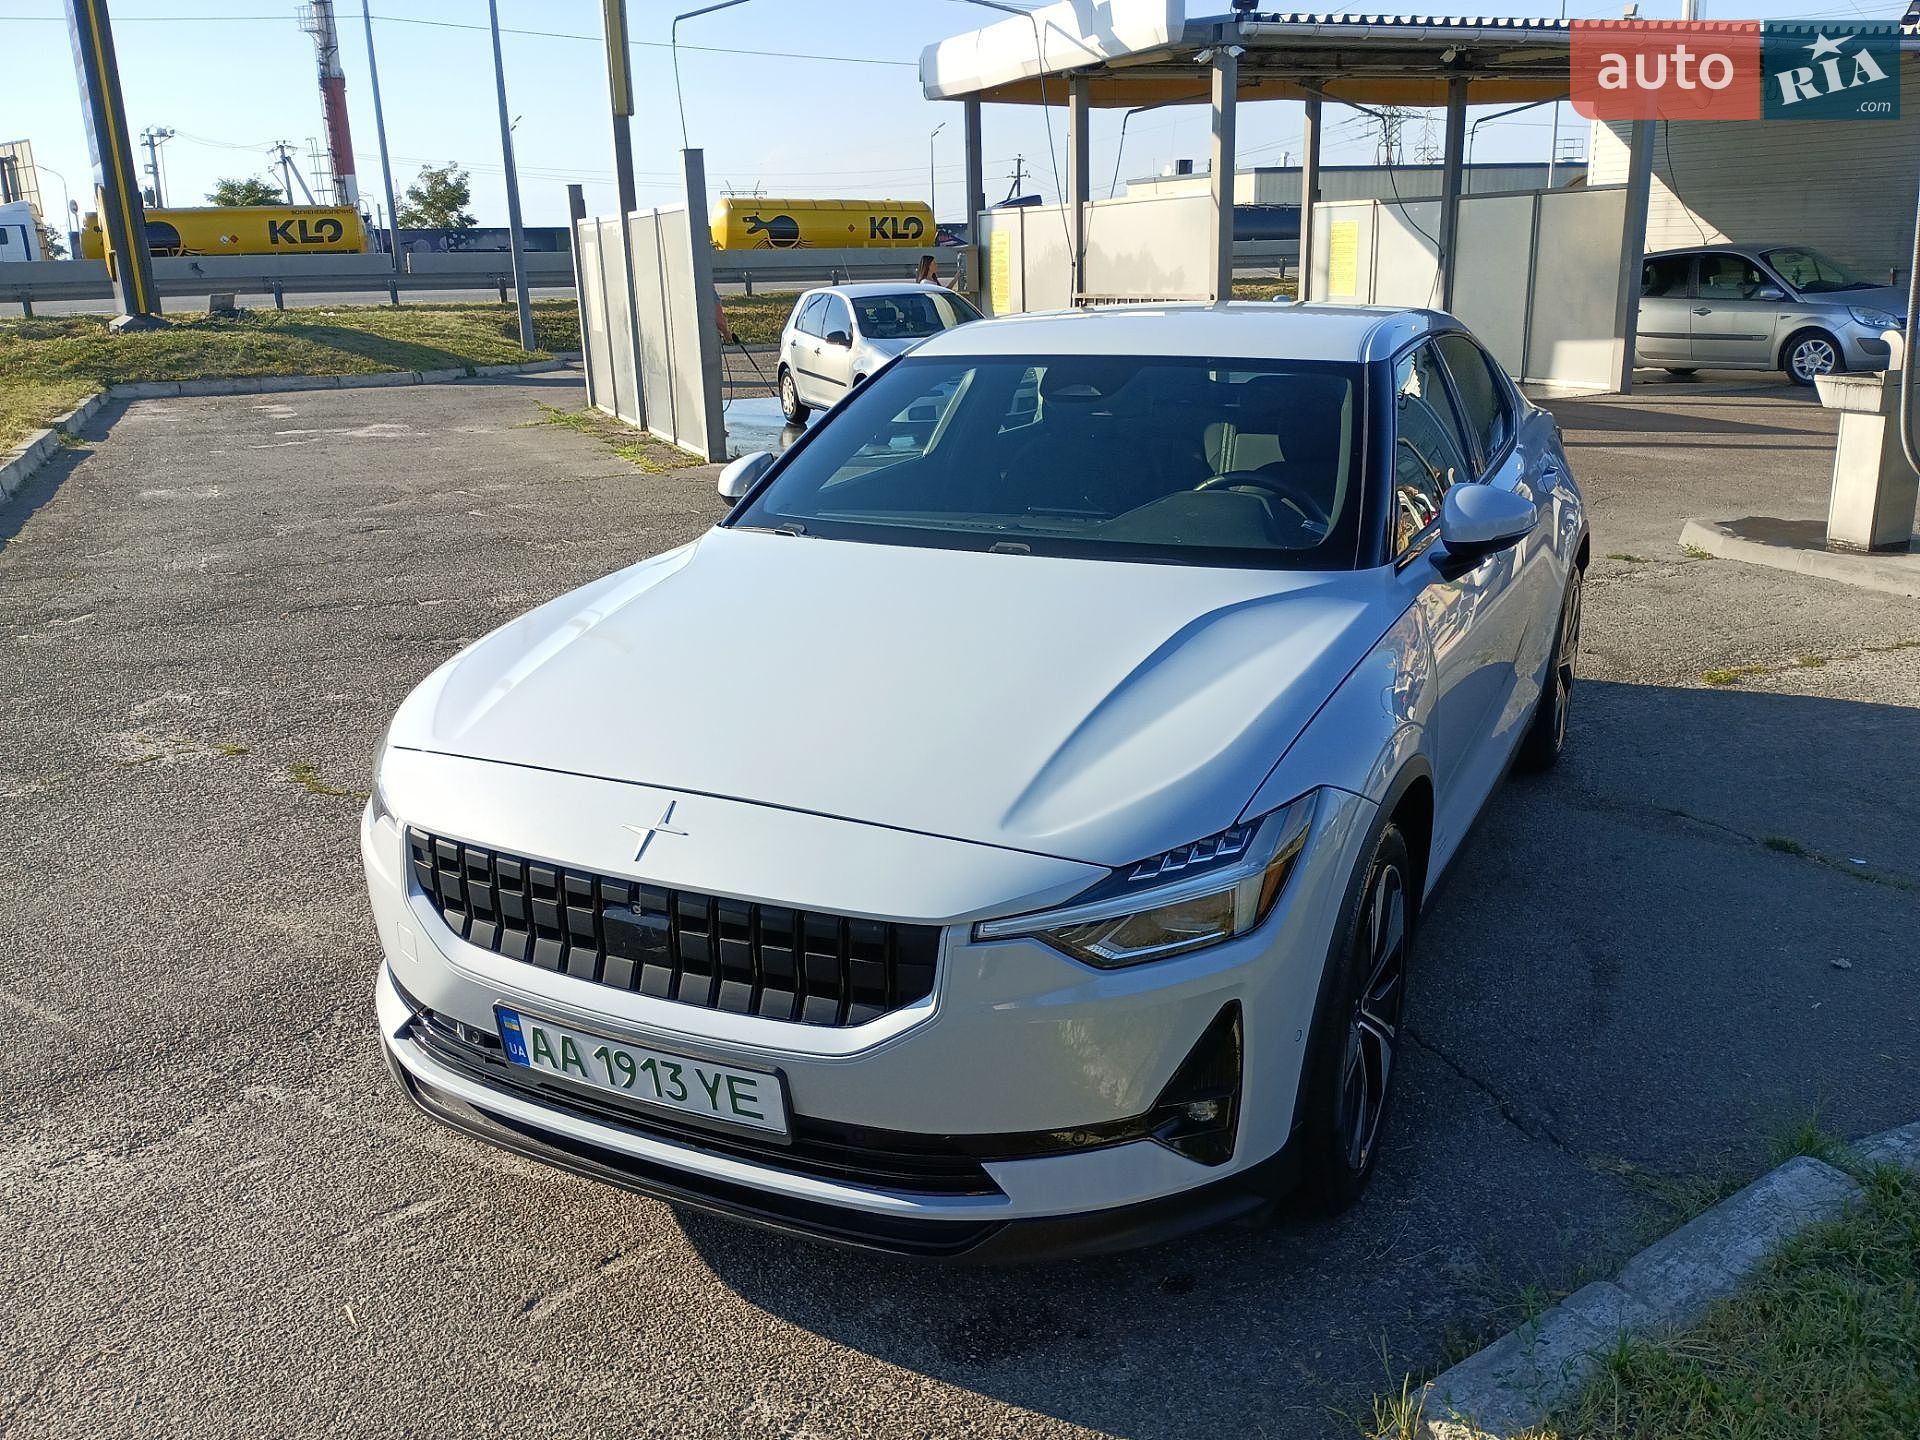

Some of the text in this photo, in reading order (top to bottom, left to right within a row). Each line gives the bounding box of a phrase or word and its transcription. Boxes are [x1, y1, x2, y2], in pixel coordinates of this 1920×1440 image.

[268, 218, 343, 245] KLO
[869, 216, 924, 240] KLO
[509, 1042, 527, 1058] UA
[531, 1025, 765, 1121] AA 1913 YE
